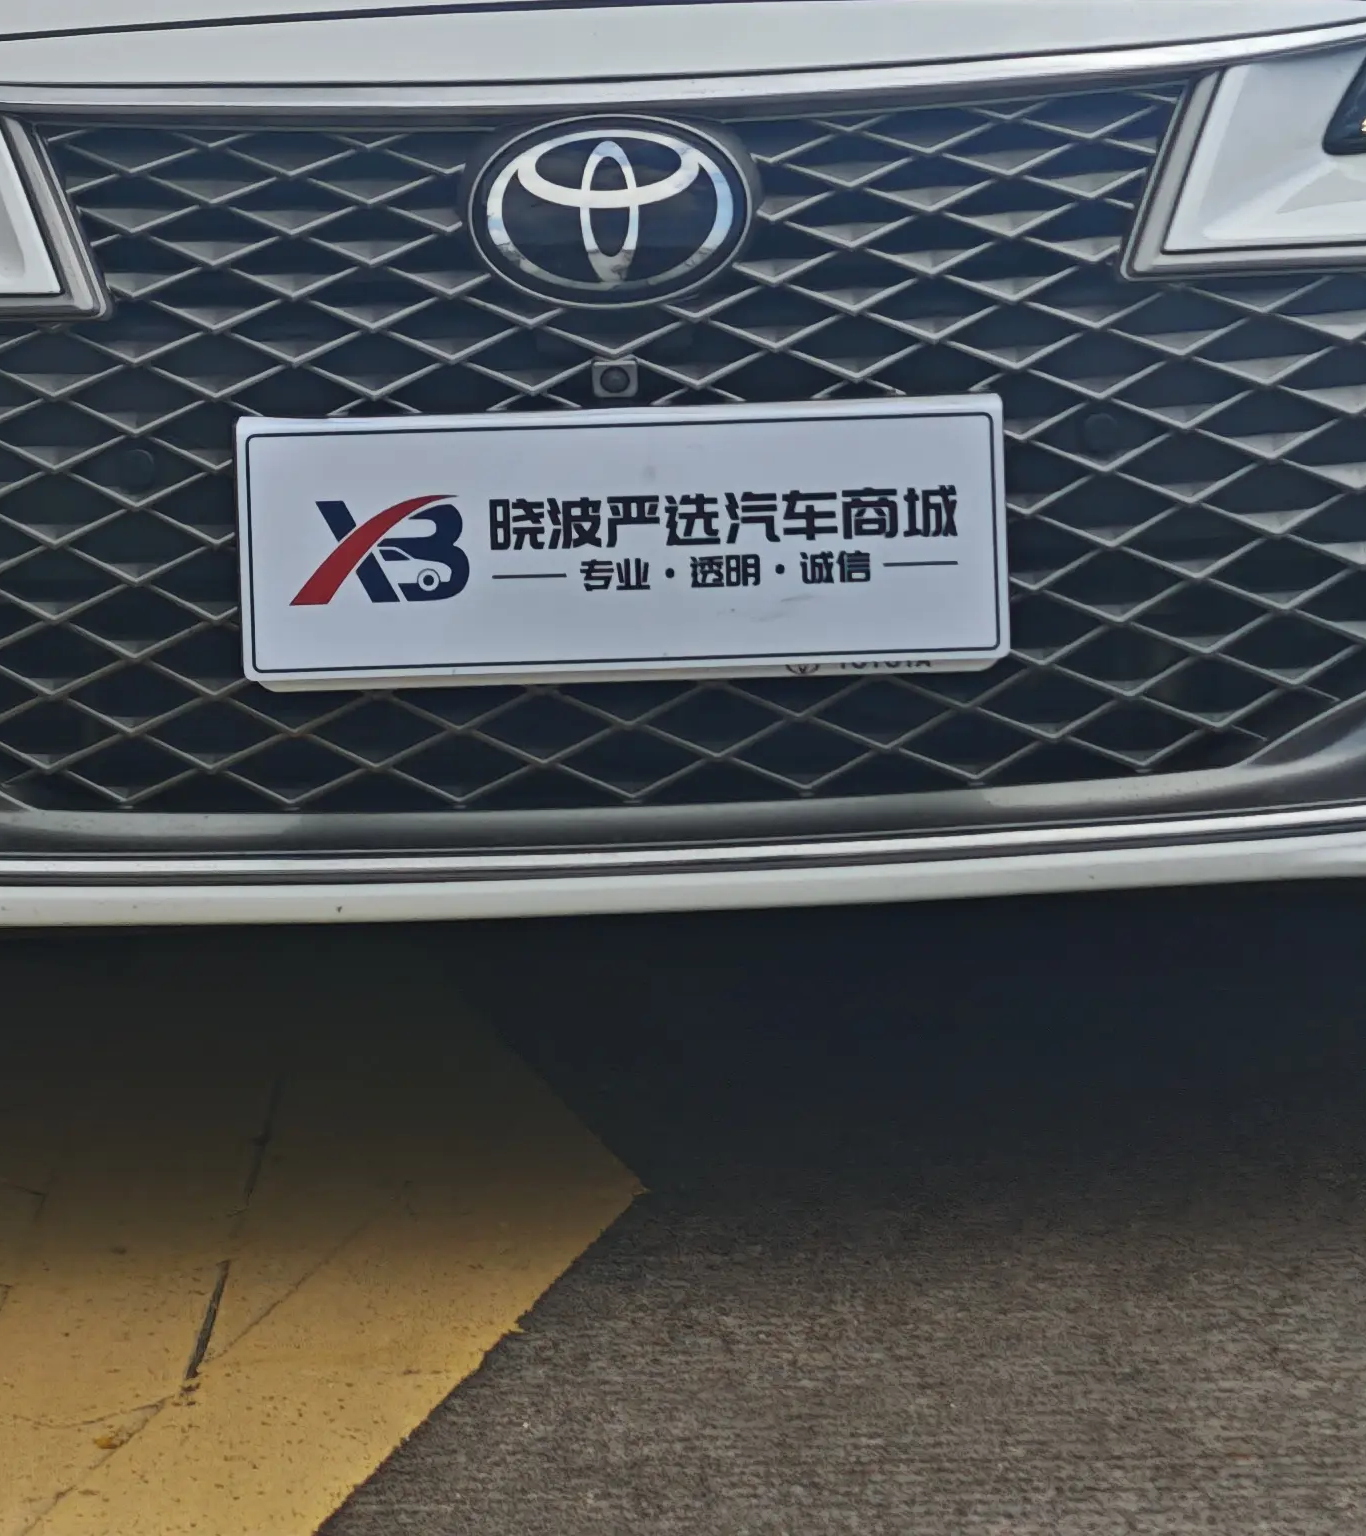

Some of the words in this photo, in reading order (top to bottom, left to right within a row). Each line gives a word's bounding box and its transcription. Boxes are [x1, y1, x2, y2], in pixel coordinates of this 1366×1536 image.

[488, 484, 959, 551] 晓波严选汽车商城
